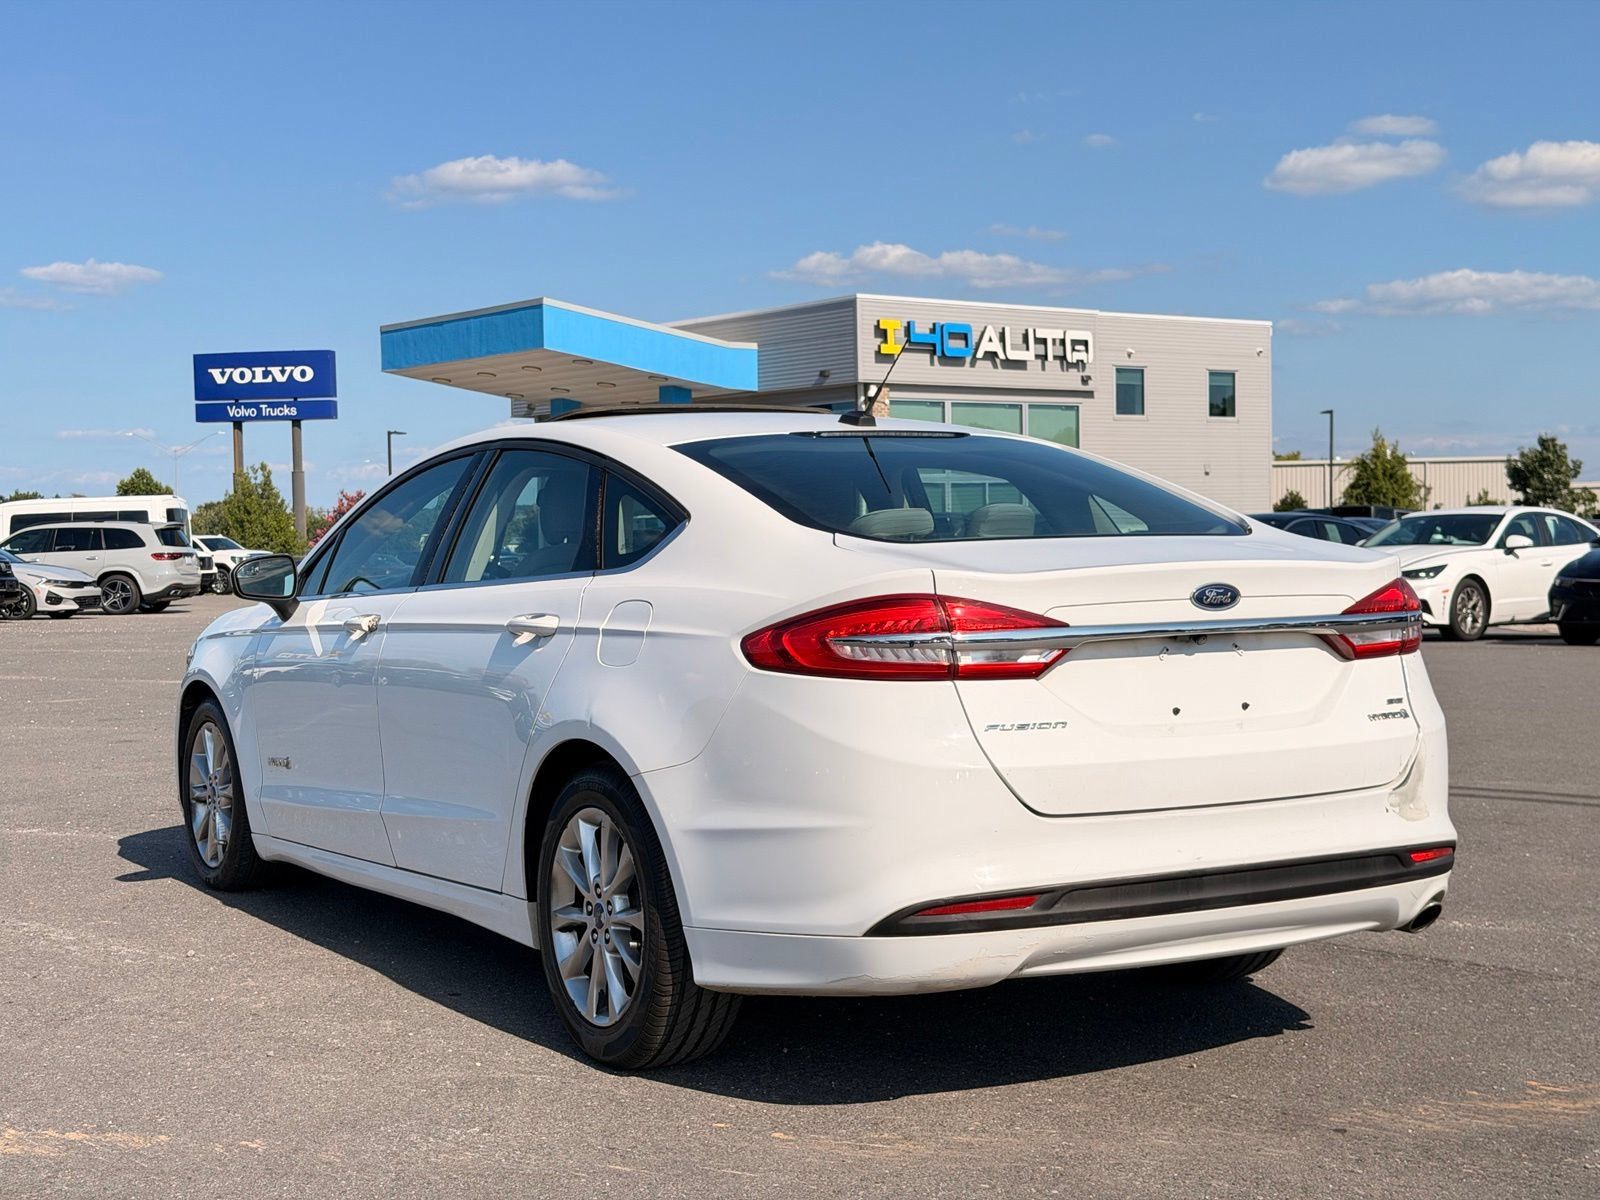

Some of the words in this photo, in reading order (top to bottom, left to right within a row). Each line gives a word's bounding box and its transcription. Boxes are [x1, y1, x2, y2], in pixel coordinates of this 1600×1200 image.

[207, 365, 315, 385] VOLVO
[226, 405, 257, 418] Volvo
[259, 403, 298, 417] Trucks
[1202, 588, 1232, 605] Ford
[983, 721, 1068, 733] FUSION
